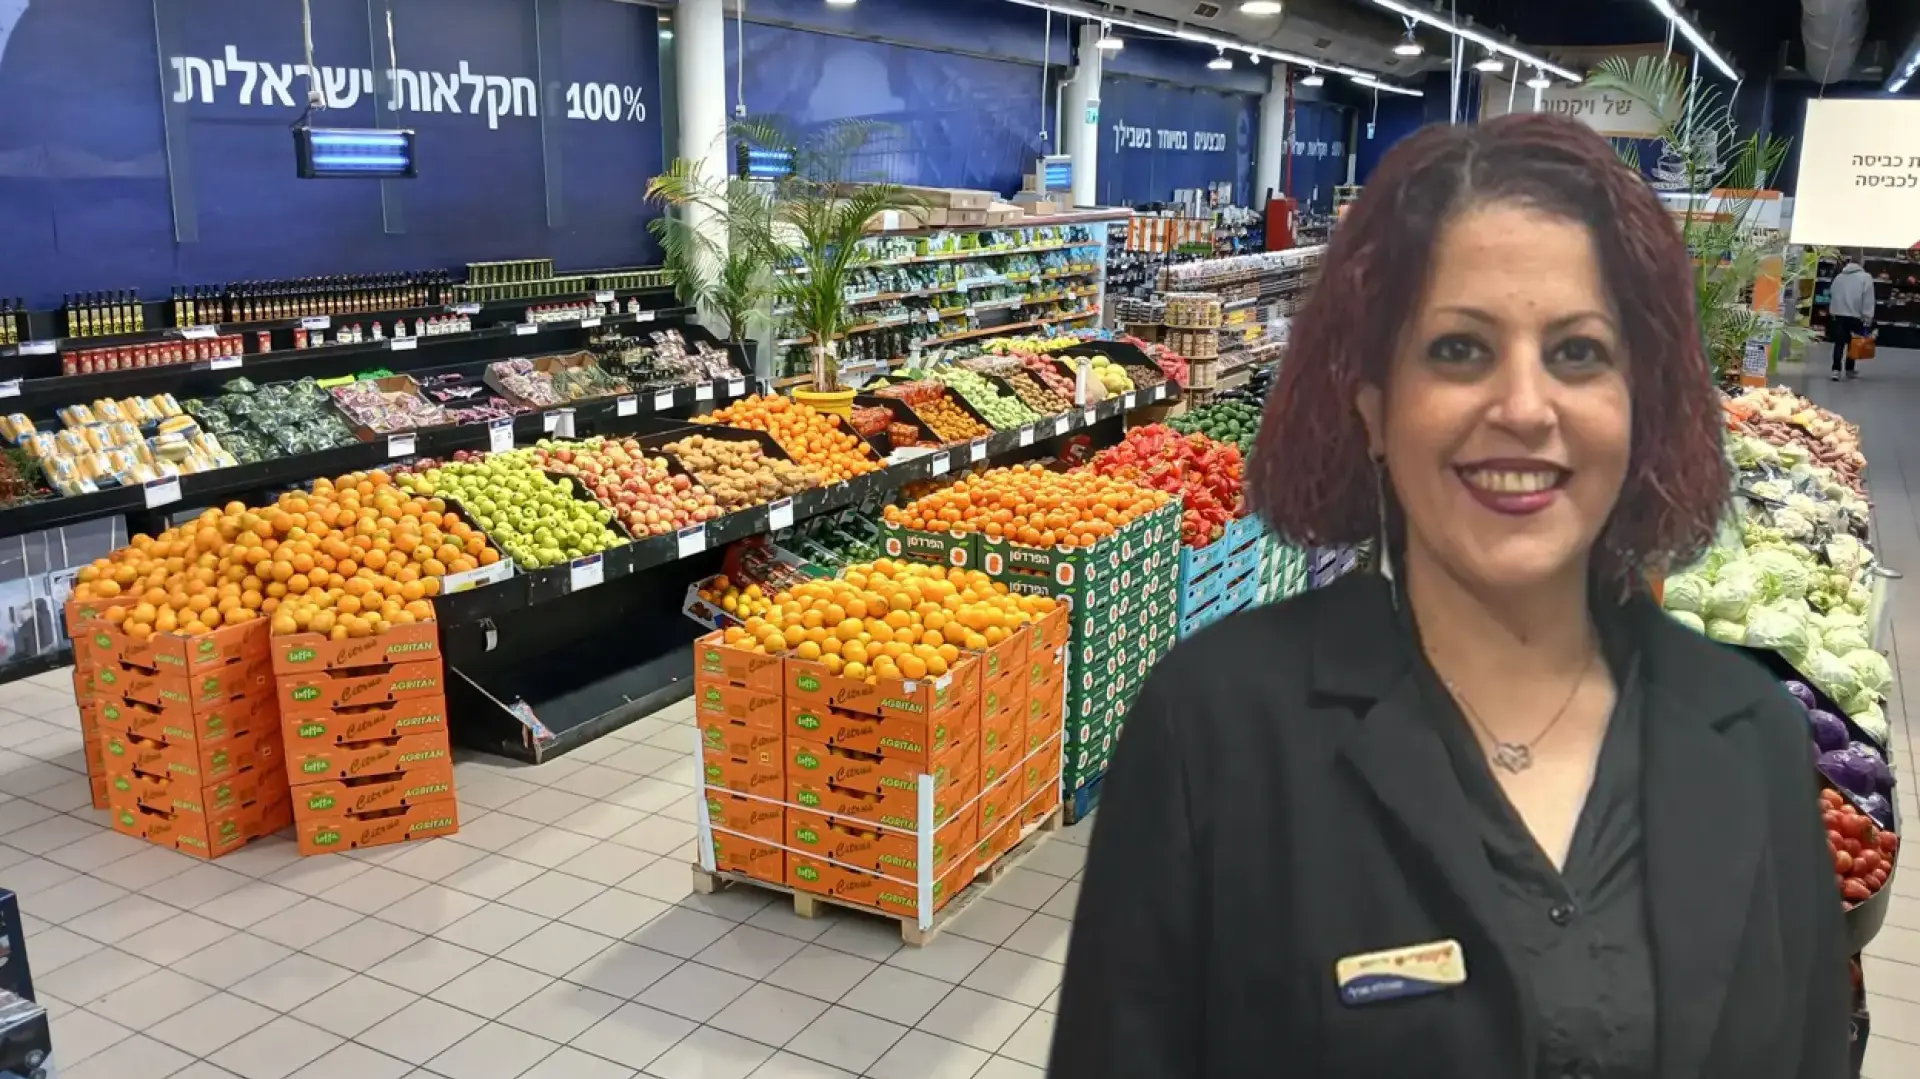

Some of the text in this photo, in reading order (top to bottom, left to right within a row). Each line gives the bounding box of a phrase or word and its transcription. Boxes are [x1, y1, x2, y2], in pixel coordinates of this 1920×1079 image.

[170, 45, 646, 130] 100% חקלאות ישראלית
[1541, 94, 1632, 118] של ויקטור
[1112, 118, 1226, 154] מבצעים במיוחד בשבילך
[1852, 154, 1904, 167] כביסה
[1855, 173, 1918, 188] לכביסה
[907, 534, 945, 549] הפרדסן
[1009, 550, 1049, 565] הפרדסן
[1009, 580, 1049, 596] הפרדסן
[386, 642, 433, 654] AGRITAN
[390, 679, 437, 691] AGRITAN
[881, 698, 924, 714] AGRITAN
[396, 715, 441, 727] AGRITAN
[880, 737, 923, 752] AGRITAN
[399, 750, 444, 762] AGRITAN
[404, 784, 449, 797] AGRITAN
[409, 819, 453, 831] AGRITAN
